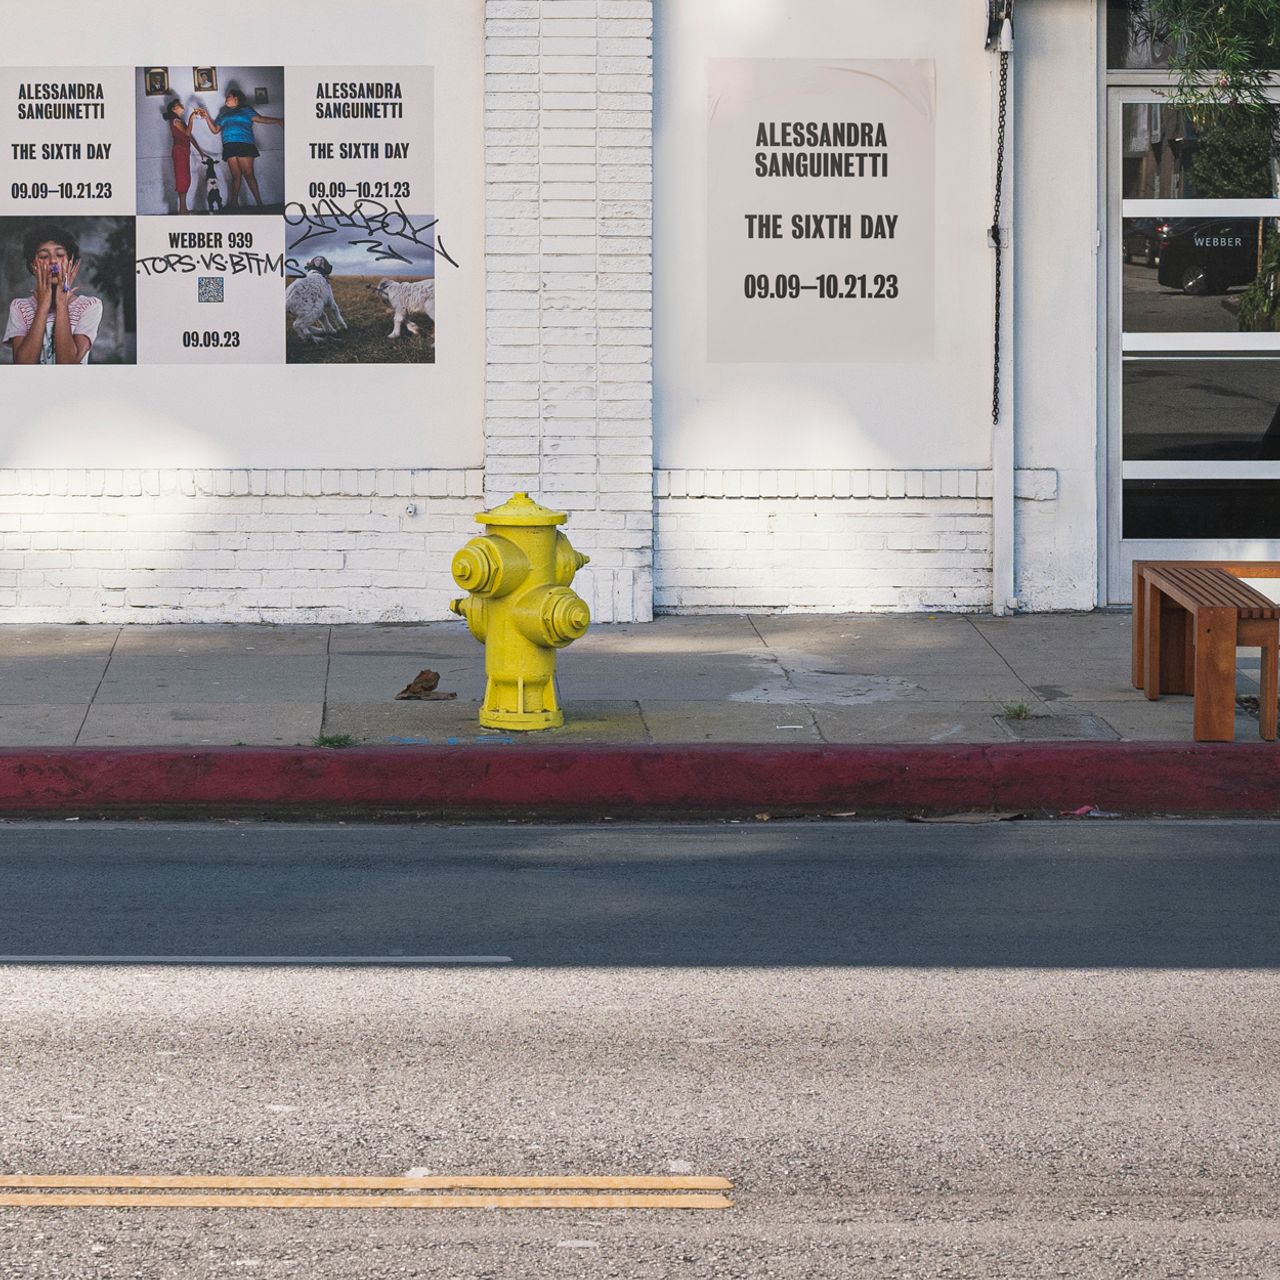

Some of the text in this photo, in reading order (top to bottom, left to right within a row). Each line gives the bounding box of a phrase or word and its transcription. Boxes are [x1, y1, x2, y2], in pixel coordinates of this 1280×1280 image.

[17, 83, 104, 101] ALESSANDRA
[315, 82, 402, 100] ALESSANDRA
[17, 103, 105, 120] SANGUINETTI
[315, 102, 403, 119] SANGUINETTI
[755, 121, 888, 148] ALESSANDRA
[10, 143, 112, 160] THE SIXTH DAY
[308, 142, 410, 159] THE SIXTH DAY
[754, 152, 888, 178] SANGUINETTI
[744, 214, 899, 240] THE SIXTH DAY
[168, 232, 253, 249] WEBBER 939
[1194, 237, 1242, 247] WEBBER
[182, 330, 241, 348] 09.09.23
